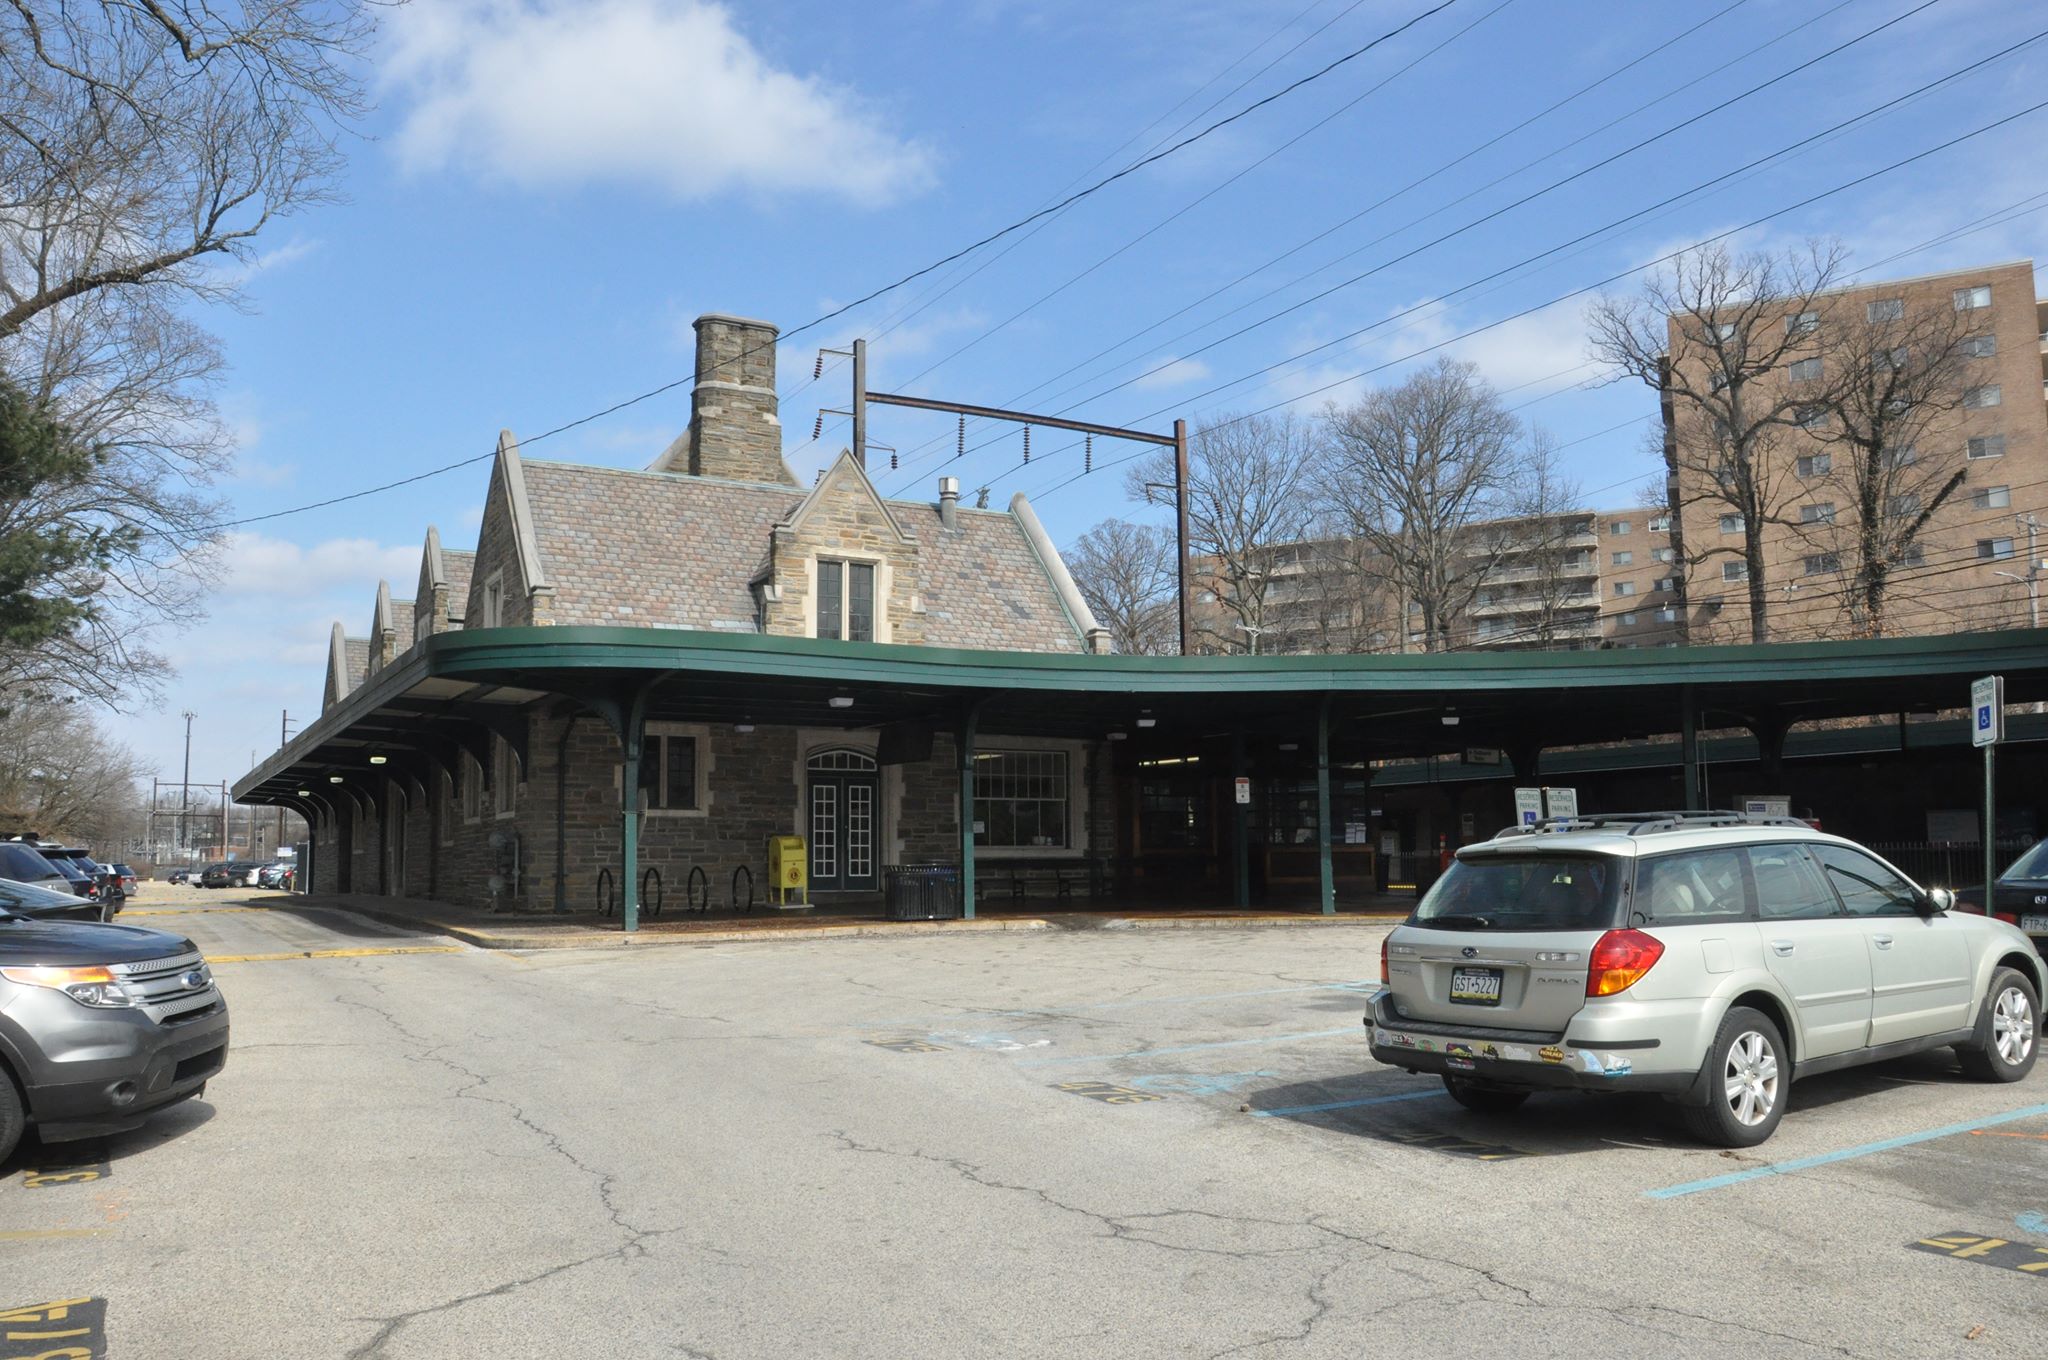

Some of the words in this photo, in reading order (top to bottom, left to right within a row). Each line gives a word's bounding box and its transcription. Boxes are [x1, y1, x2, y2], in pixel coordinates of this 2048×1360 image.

[1517, 793, 1540, 801] RESERVED
[1549, 794, 1572, 802] RESERVED
[1519, 802, 1539, 810] PARKING
[1551, 804, 1572, 813] PARKING
